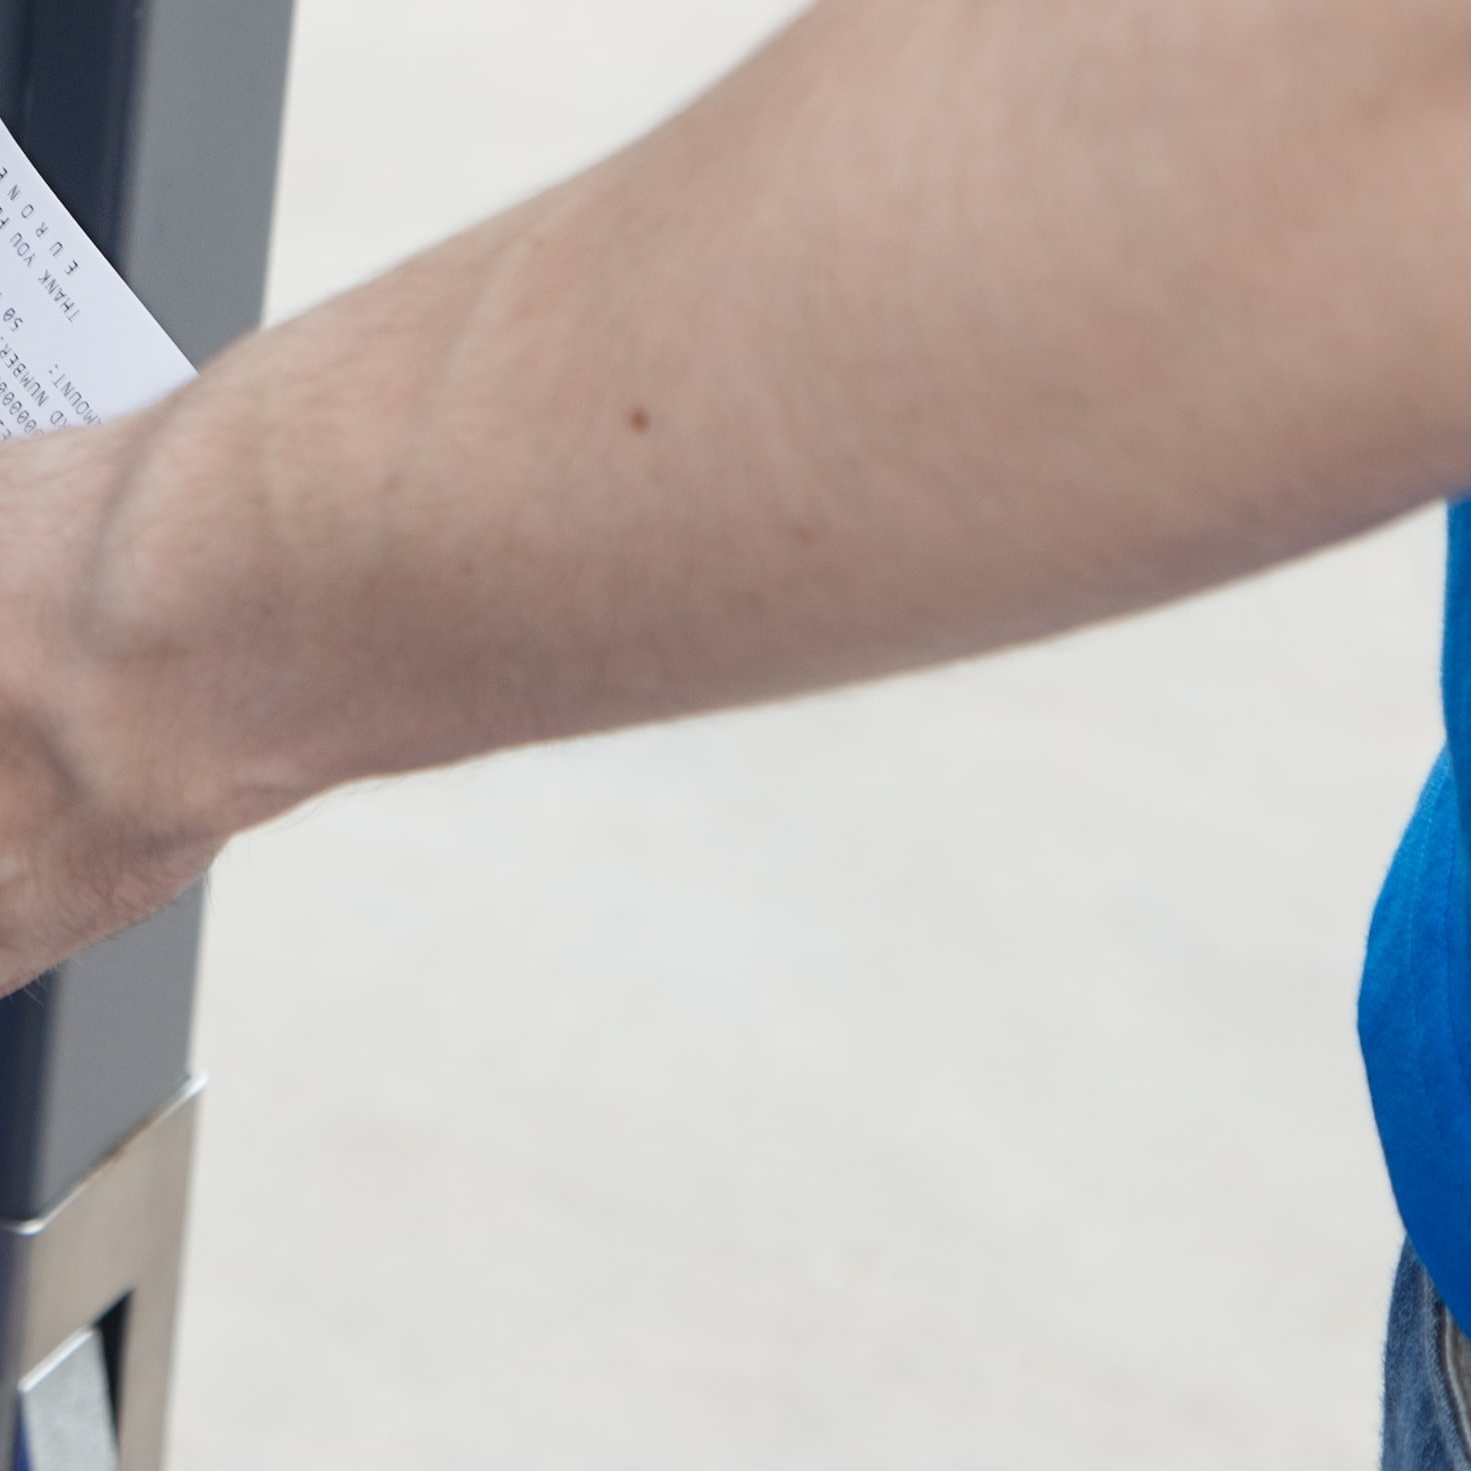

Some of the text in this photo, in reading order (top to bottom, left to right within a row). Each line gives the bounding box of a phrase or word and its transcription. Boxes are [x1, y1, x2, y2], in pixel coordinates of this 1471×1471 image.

[9, 233, 38, 268] YOU
[37, 272, 81, 324] THANK
[2, 307, 25, 332] 50
